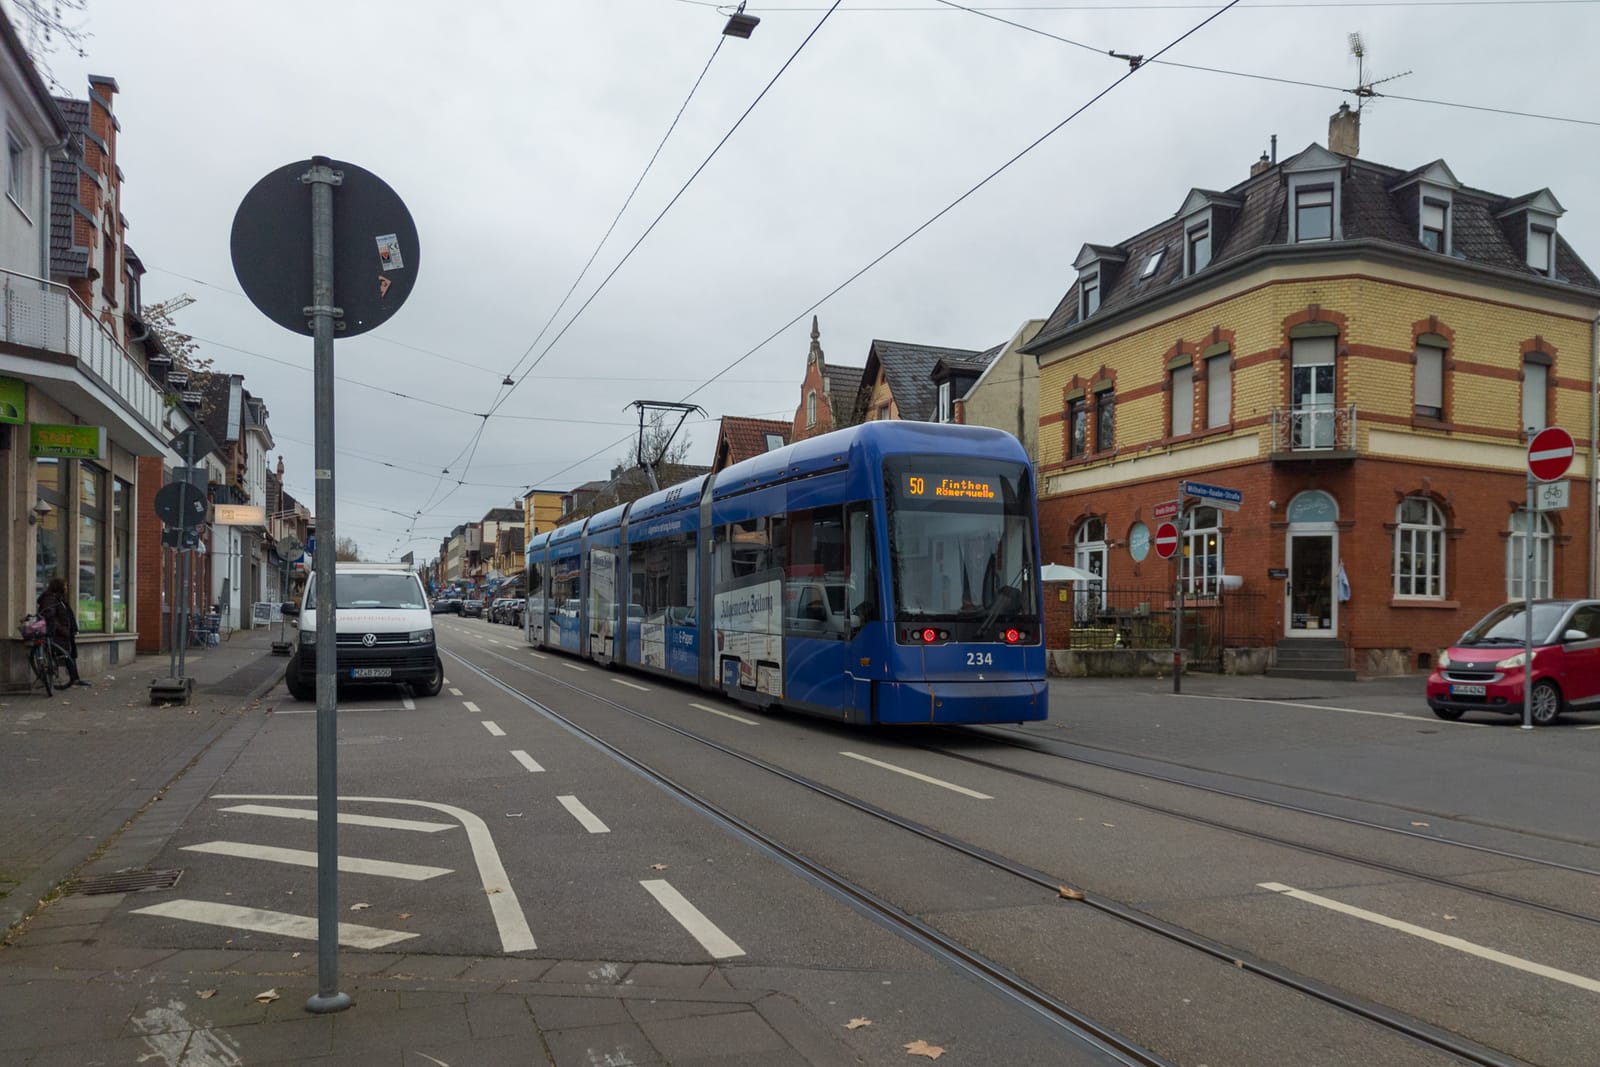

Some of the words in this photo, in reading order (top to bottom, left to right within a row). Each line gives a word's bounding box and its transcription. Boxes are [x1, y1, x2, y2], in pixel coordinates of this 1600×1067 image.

[909, 477, 925, 495] 50
[942, 479, 989, 490] Finthen
[936, 487, 994, 498] Römerquelle
[721, 598, 750, 618] Allgemeine
[750, 593, 774, 617] Zeitung
[966, 652, 993, 666] 234
